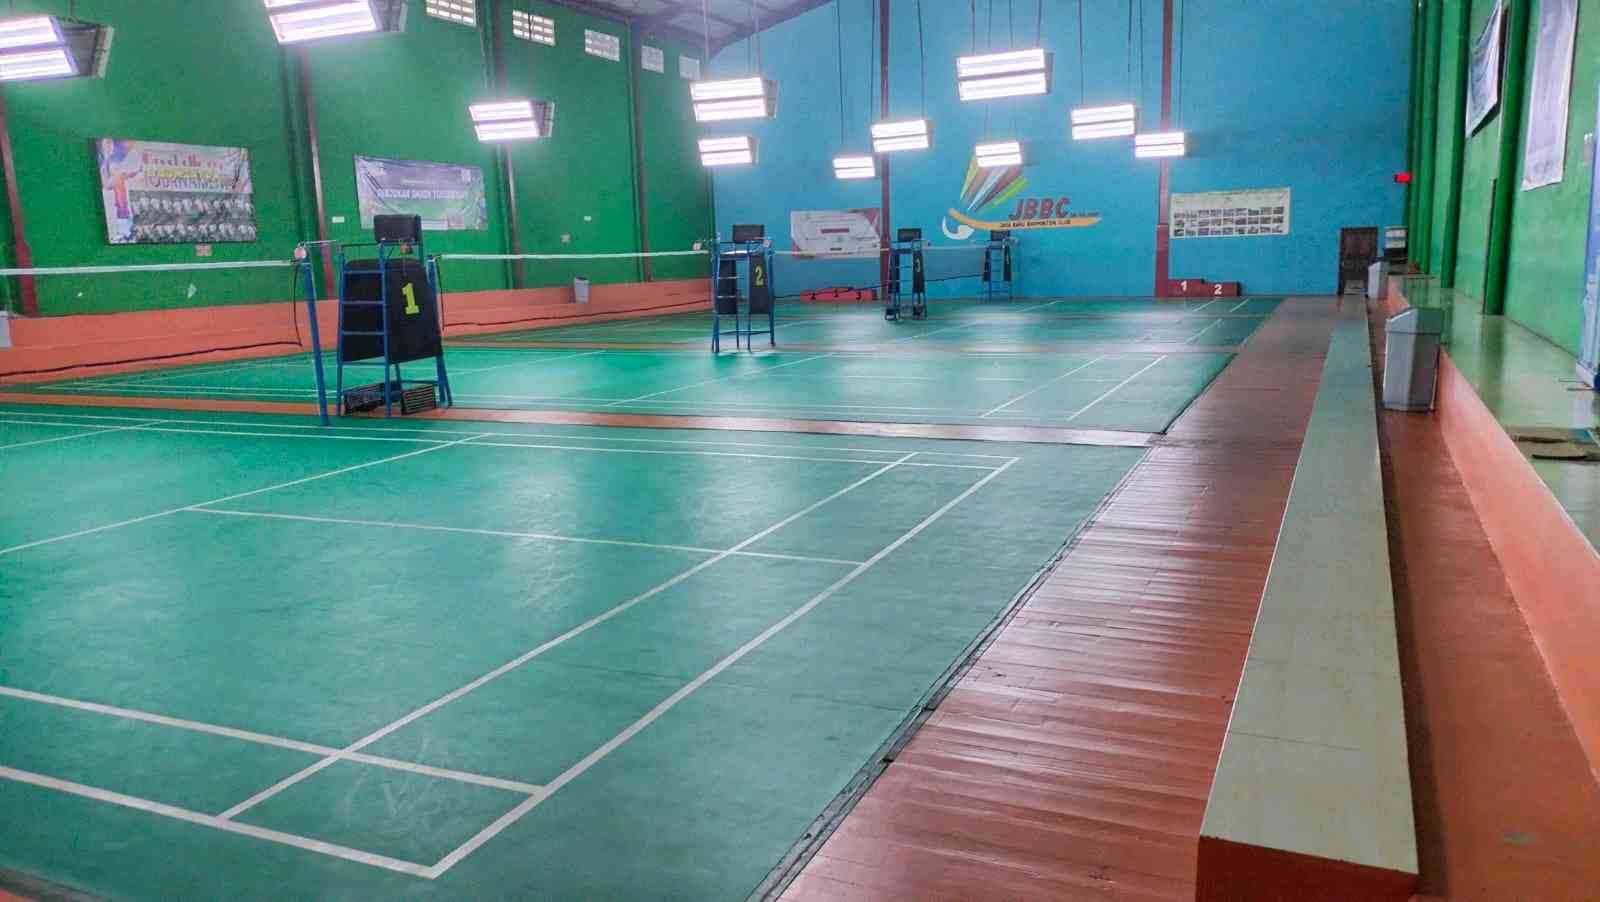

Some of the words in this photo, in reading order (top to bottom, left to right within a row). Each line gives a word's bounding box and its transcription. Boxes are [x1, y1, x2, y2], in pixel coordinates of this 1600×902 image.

[1008, 197, 1071, 220] JBBC
[915, 258, 922, 272] 3
[754, 264, 765, 287] 2
[1180, 280, 1188, 292] 1
[1214, 284, 1222, 295] 2
[402, 282, 420, 316] 1
